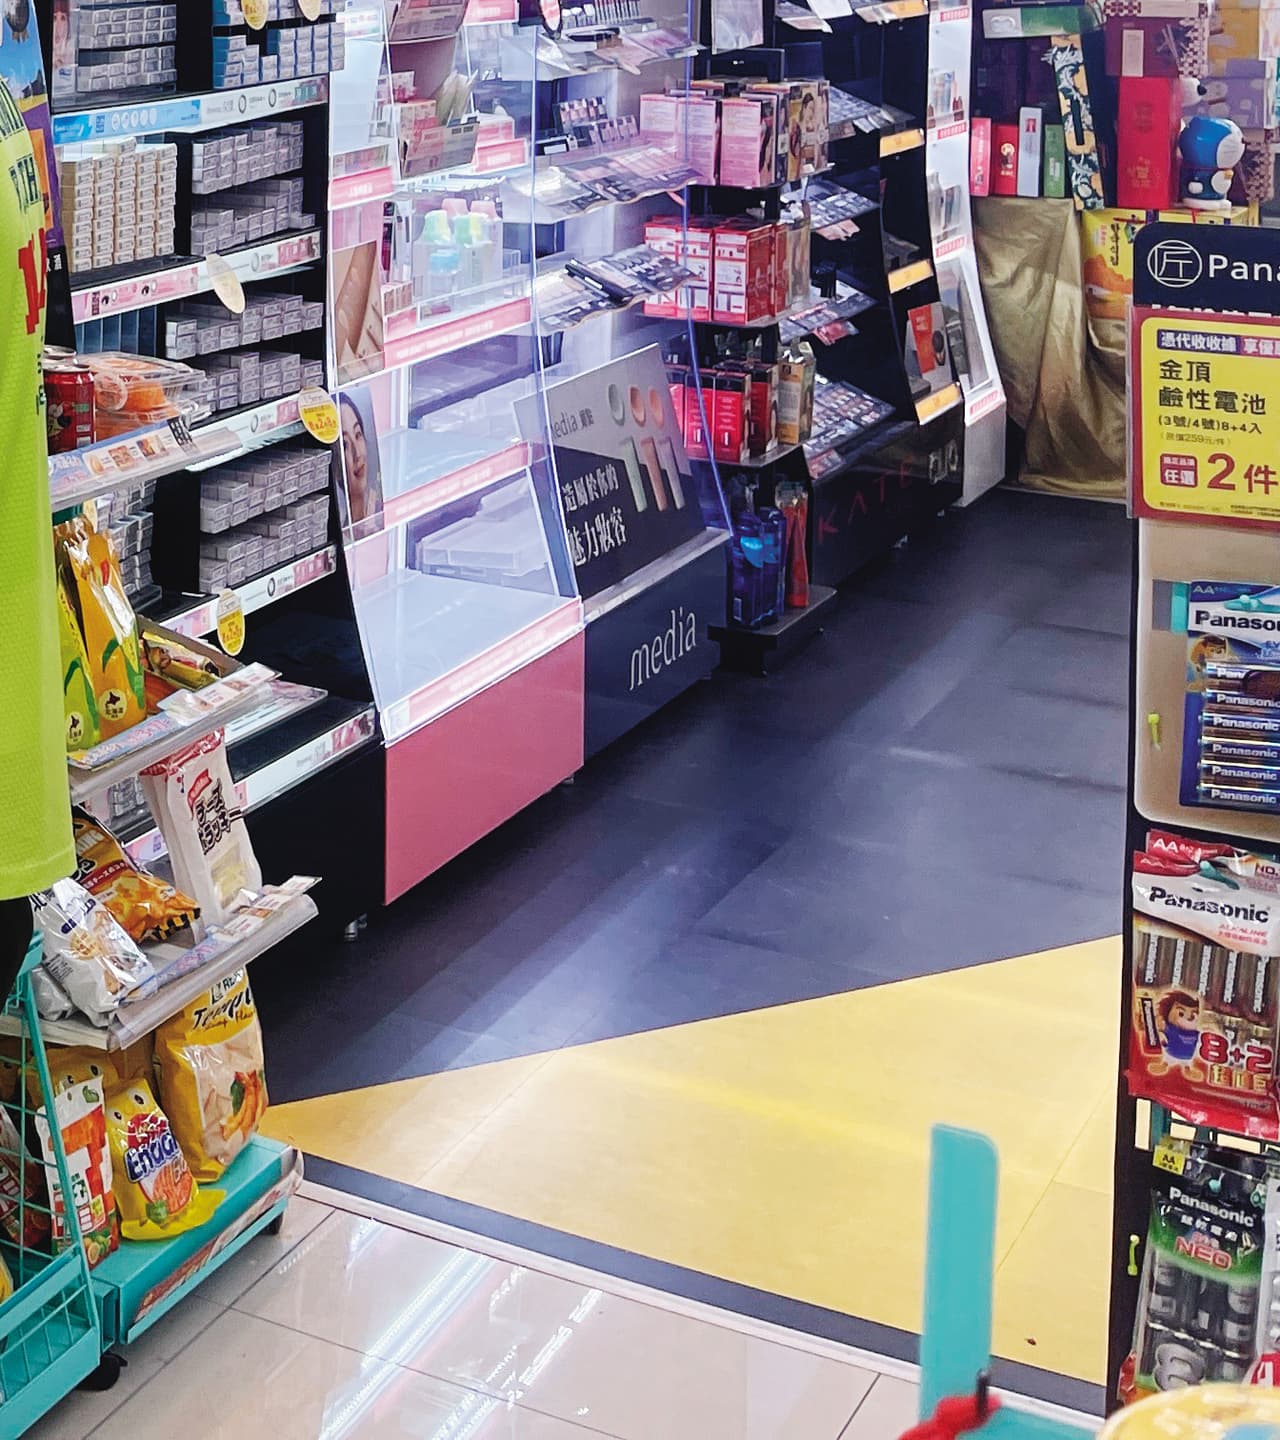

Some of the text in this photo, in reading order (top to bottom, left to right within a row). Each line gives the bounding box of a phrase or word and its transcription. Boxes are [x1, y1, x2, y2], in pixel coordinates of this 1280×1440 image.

[1159, 359, 1211, 383] 金頂
[1158, 388, 1266, 416] 鹼性電池
[1164, 469, 1197, 487] 任選
[629, 605, 697, 691] media
[1213, 716, 1279, 731] Panasonic
[1213, 744, 1278, 758] Panasonic
[1212, 766, 1278, 780] Panasonic
[1211, 790, 1277, 804] Panasonic
[1153, 838, 1178, 855] AA
[1149, 886, 1270, 924] Panasonic
[1170, 1185, 1257, 1228] Panasonic
[1176, 1235, 1232, 1270] NEO
